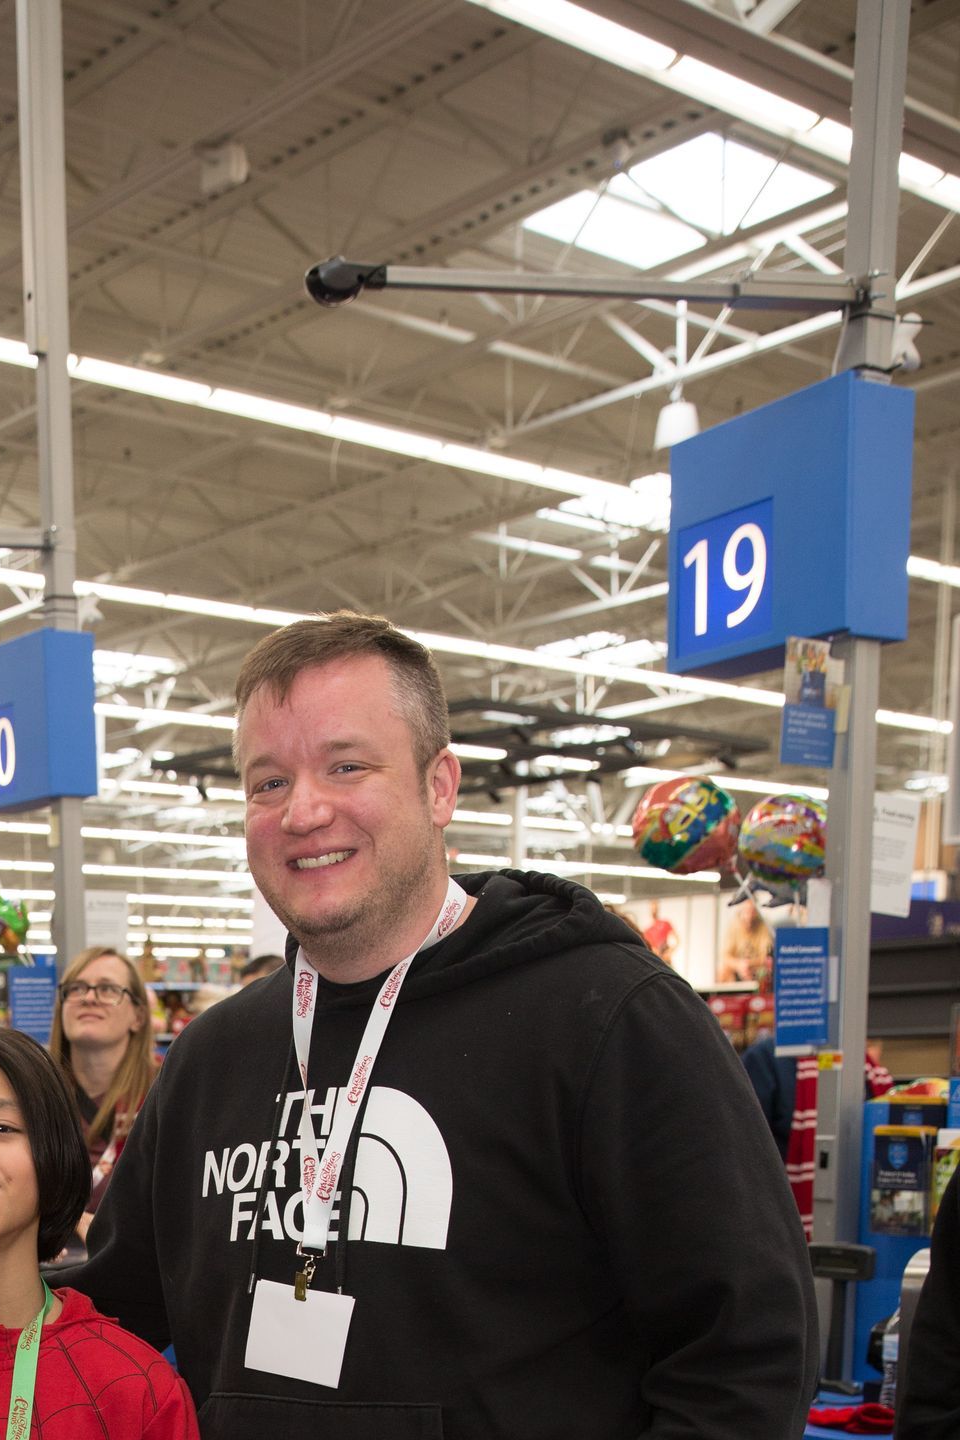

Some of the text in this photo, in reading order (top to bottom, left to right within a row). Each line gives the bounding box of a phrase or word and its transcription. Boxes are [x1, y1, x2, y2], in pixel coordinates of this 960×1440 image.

[683, 522, 768, 637] 19
[297, 969, 315, 1018] Christmas
[347, 1055, 373, 1106] Christmas
[276, 1087, 342, 1137] TH
[202, 1139, 327, 1198] NORT
[316, 1151, 342, 1203] Christmas
